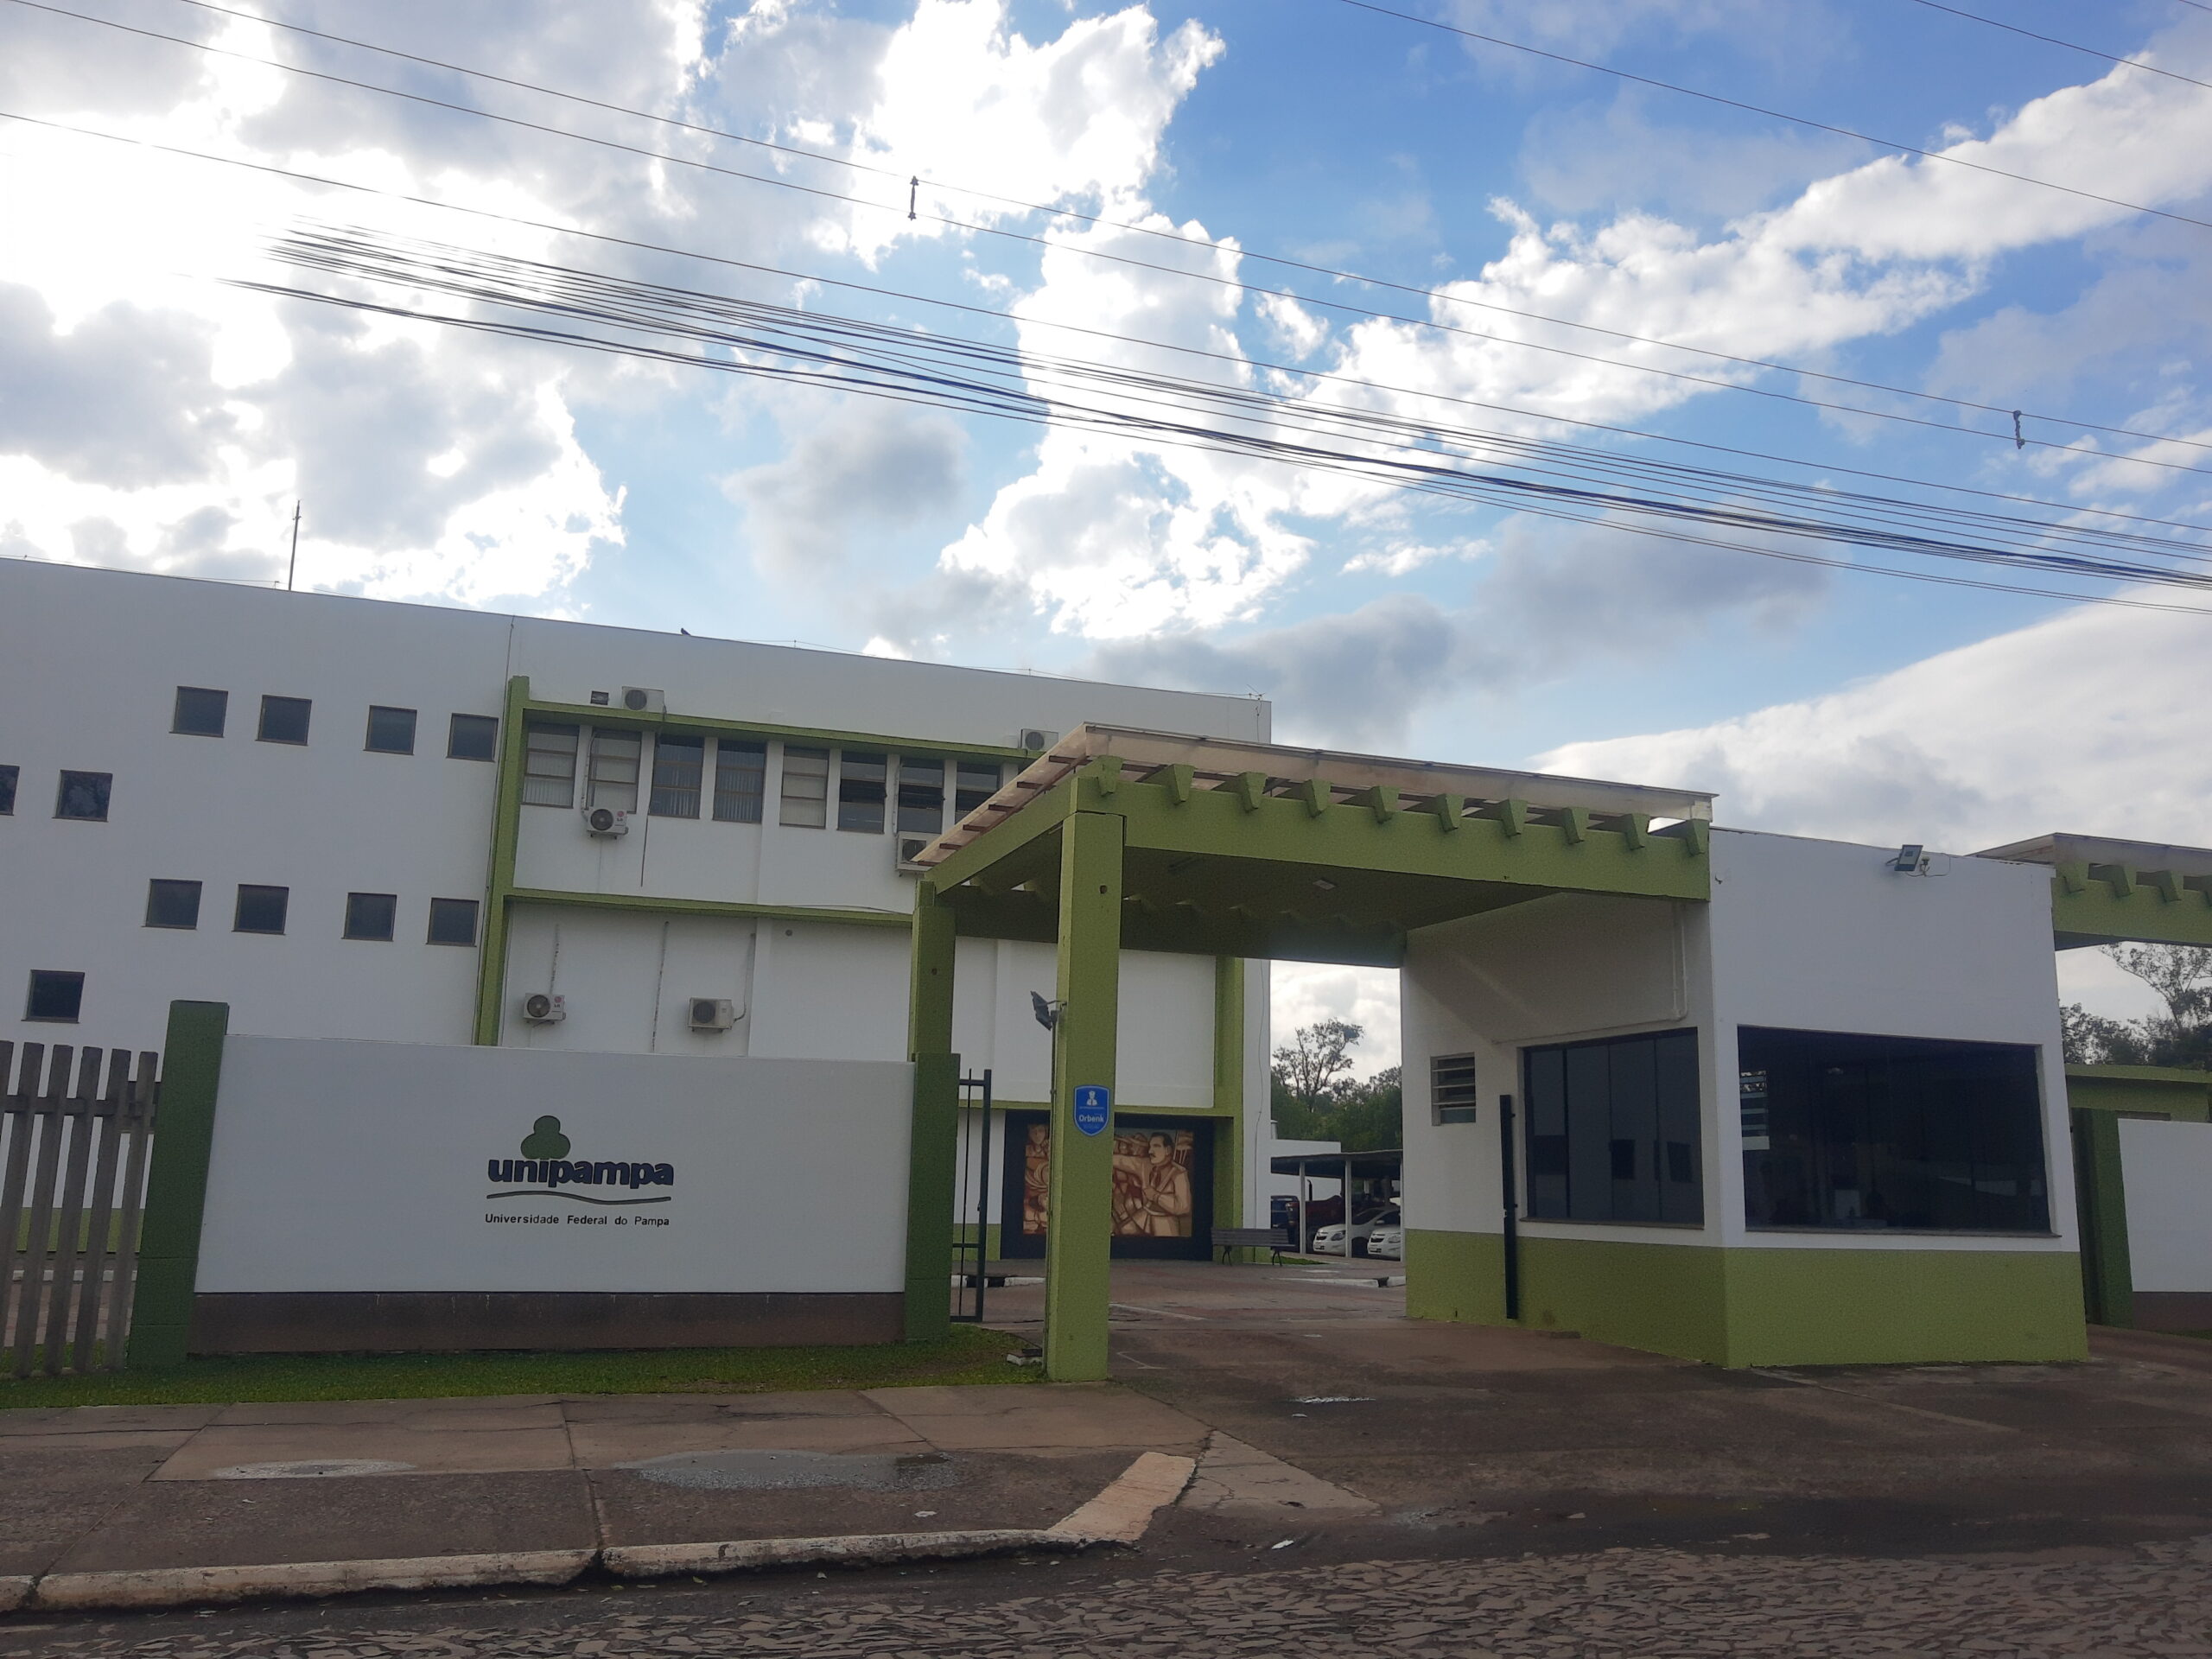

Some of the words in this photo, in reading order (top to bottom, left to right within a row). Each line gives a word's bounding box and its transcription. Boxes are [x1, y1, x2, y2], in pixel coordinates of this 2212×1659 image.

[487, 1159, 674, 1189] unipampa
[485, 1213, 559, 1224] Universidade
[567, 1215, 607, 1224] Federal
[614, 1216, 628, 1225] do
[634, 1216, 670, 1227] Pampa
